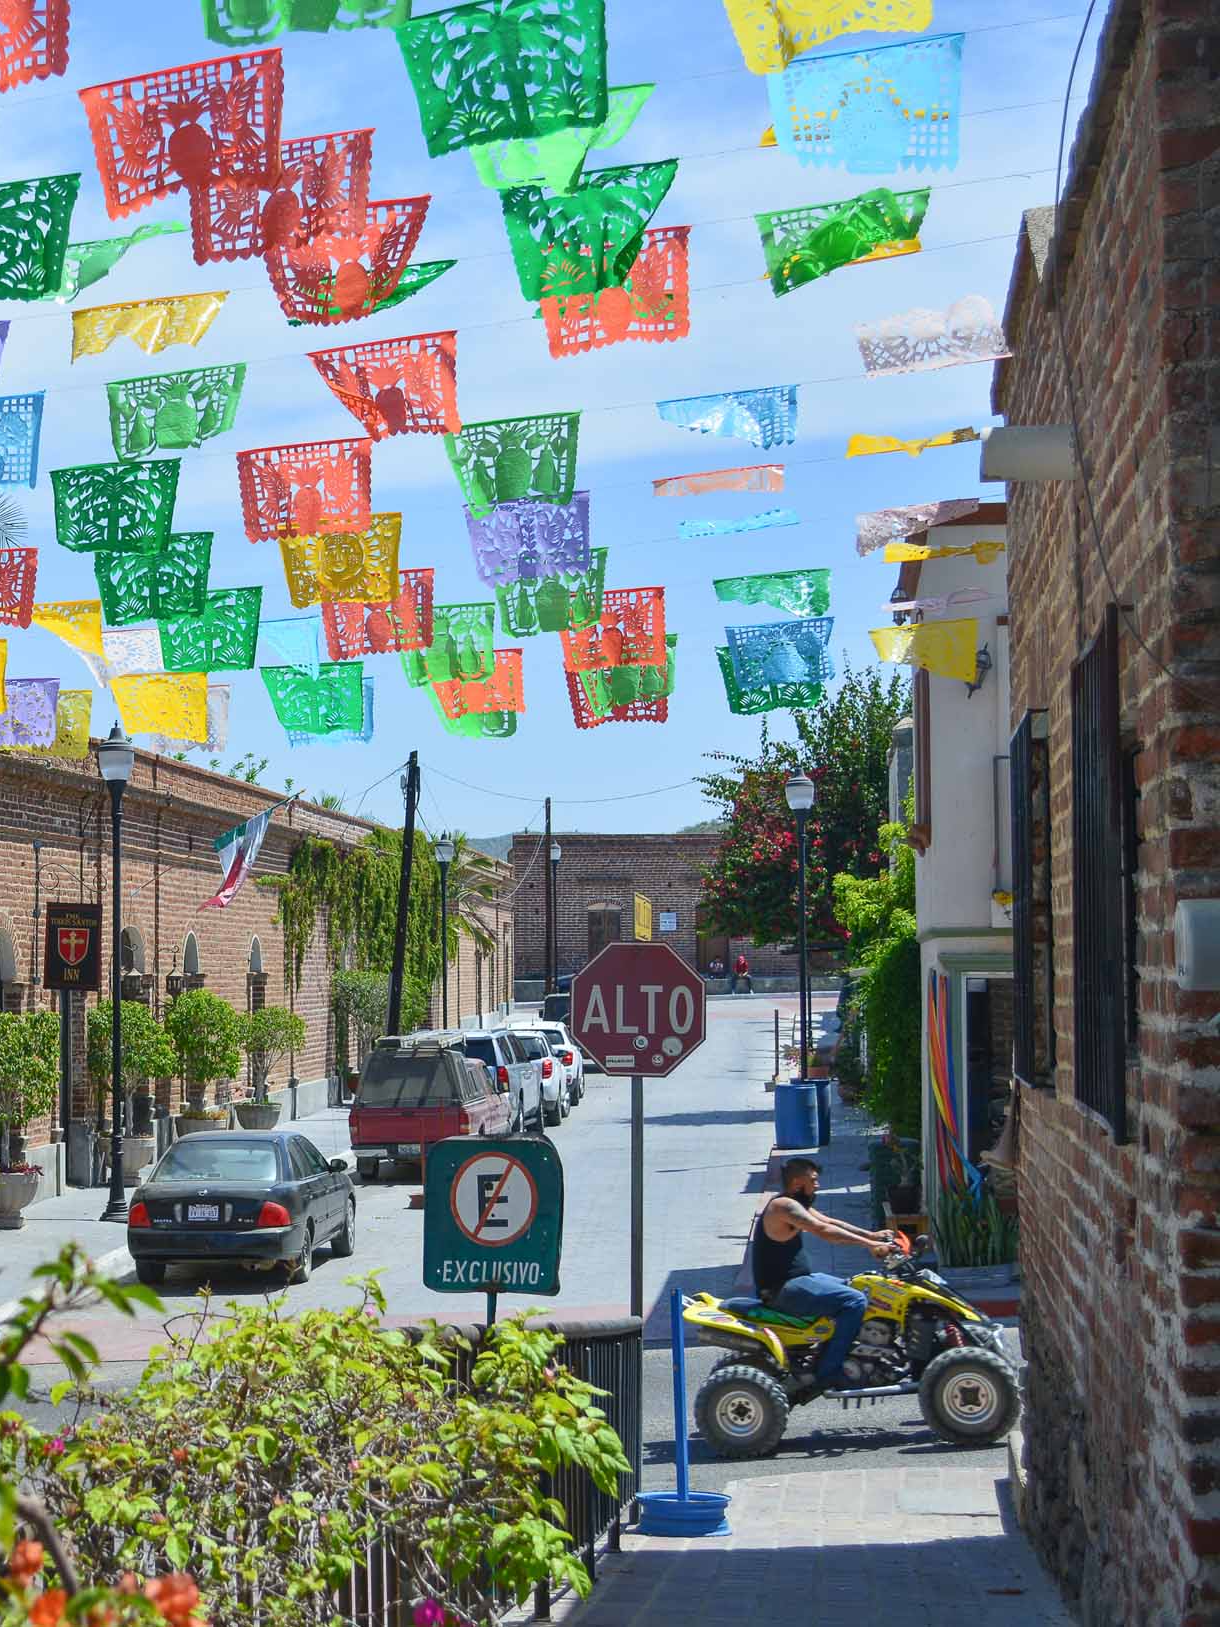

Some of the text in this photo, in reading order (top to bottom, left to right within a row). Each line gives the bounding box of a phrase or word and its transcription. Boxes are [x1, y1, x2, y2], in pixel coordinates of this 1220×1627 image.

[63, 967, 80, 983] INN
[581, 984, 694, 1034] ALTO
[477, 1173, 508, 1227] E
[442, 1260, 540, 1285] EXCLUSIVO
